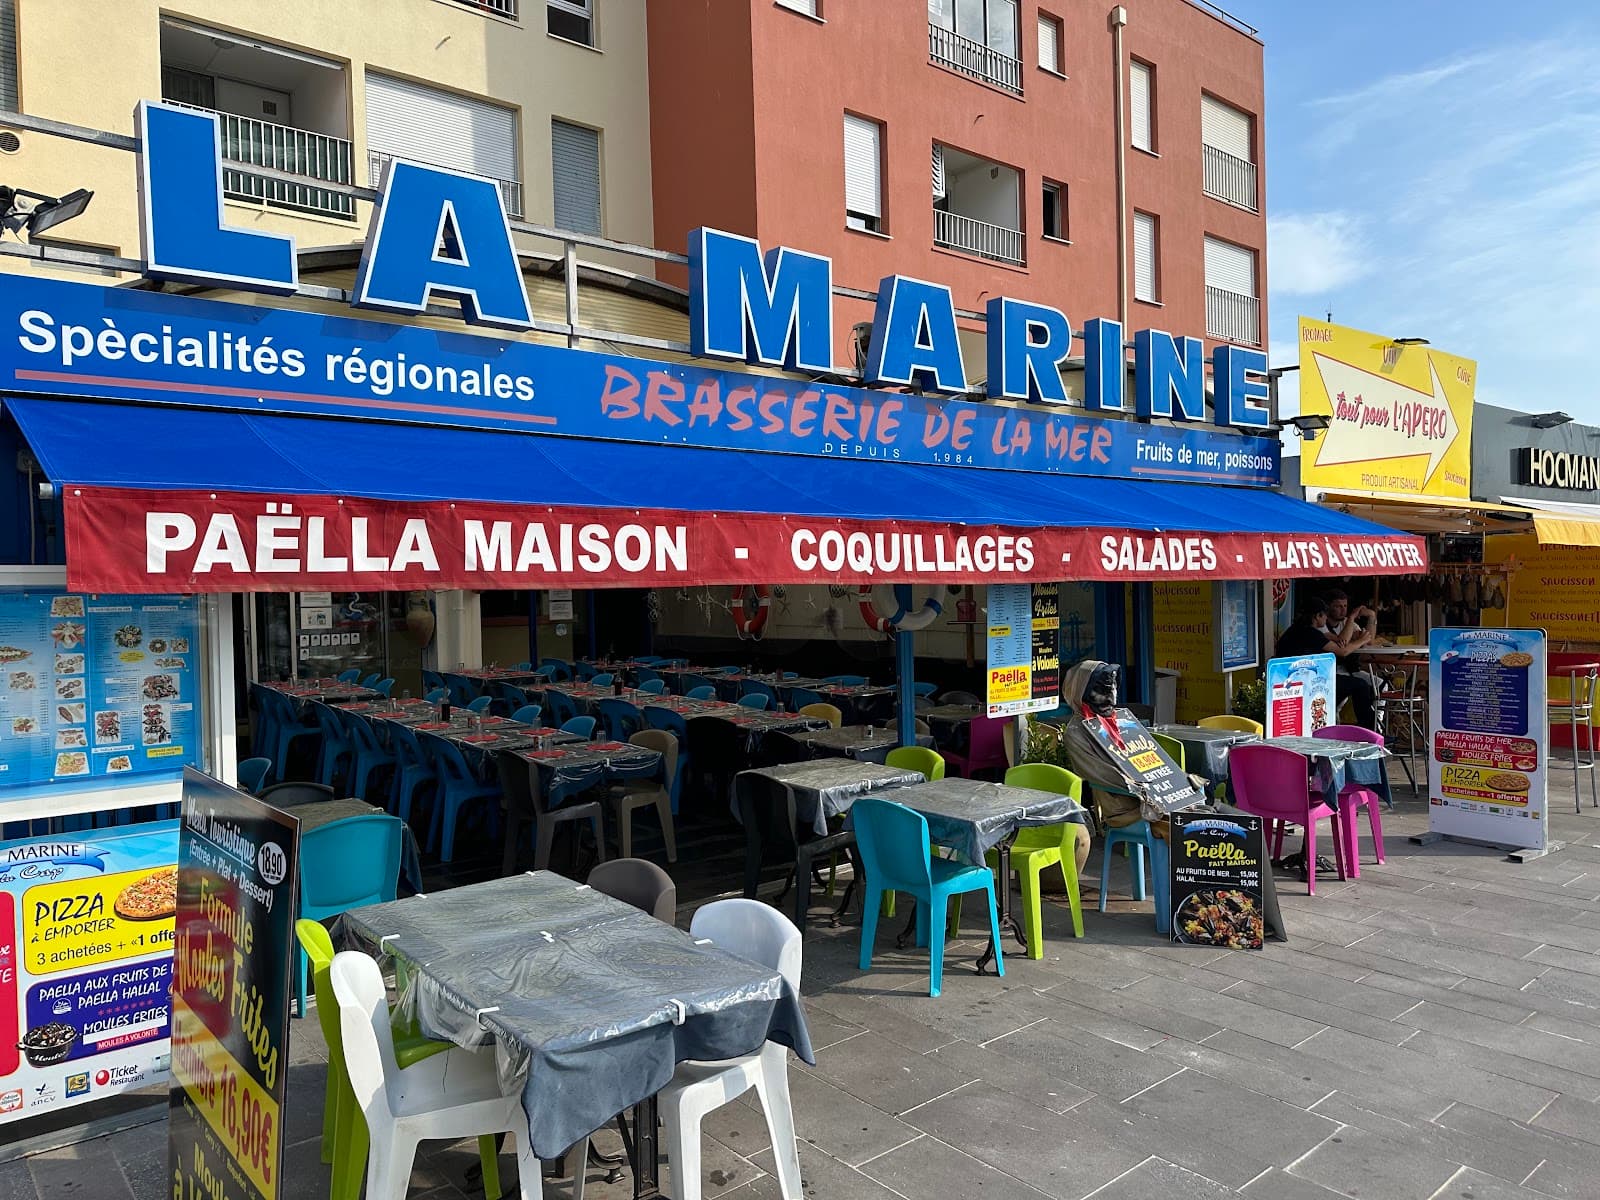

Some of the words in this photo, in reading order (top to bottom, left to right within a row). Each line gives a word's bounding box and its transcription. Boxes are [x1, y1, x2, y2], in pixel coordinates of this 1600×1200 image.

[134, 99, 535, 330] LA
[688, 226, 1269, 430] MARINE
[18, 309, 306, 377] Spècialités
[325, 350, 536, 401] régionales
[600, 364, 903, 444] BRASSERIE
[921, 403, 976, 450] DE
[991, 416, 1032, 458] LA
[1045, 421, 1112, 465] MER
[1336, 391, 1363, 423] tout
[1360, 404, 1390, 430] pour
[825, 442, 900, 459] DEPUIS
[1137, 439, 1174, 462] Fruits
[1178, 443, 1193, 465] de
[1196, 450, 1221, 470] mer,
[1225, 449, 1273, 471] poissons
[1361, 473, 1388, 488] PRODUIT
[145, 502, 441, 575] PAËLLA
[463, 519, 689, 573] MAISON
[791, 528, 1035, 575] COQUILLAGES
[1262, 541, 1325, 569] PLATS
[1325, 536, 1340, 568] À
[1341, 542, 1424, 568] EMPORTER
[1471, 650, 1497, 663] PIZZAS
[992, 669, 1026, 684] Paëlla
[1437, 732, 1460, 740] PAELLA
[1485, 735, 1495, 744] DE
[1443, 740, 1467, 748] PAELLA
[1461, 751, 1489, 760] MOULES
[1446, 767, 1480, 781] PIZZA
[1152, 780, 1173, 793] PLAT
[1163, 786, 1196, 804] DESSERT
[209, 807, 256, 866] Touristique
[8, 844, 81, 863] MARINE
[1183, 839, 1247, 860] Paëlla
[1176, 867, 1185, 875] AU
[1186, 867, 1207, 876] FRUITS
[1207, 869, 1216, 877] DE
[1216, 870, 1230, 878] MER
[1226, 859, 1257, 867] MAISON
[217, 856, 232, 881] Plat
[239, 871, 274, 914] Dessert)
[35, 892, 104, 927] PIZZA
[200, 876, 254, 955] Formule
[44, 917, 116, 941] EMPORTER
[36, 952, 46, 966] 3
[50, 941, 113, 963] achetées
[39, 981, 81, 1002] PAELLA
[83, 975, 109, 993] AUX
[112, 965, 149, 988] FRUITS
[152, 963, 168, 978] DE
[78, 991, 118, 1010] PAELLA
[122, 980, 161, 999] HALLAL
[83, 1018, 129, 1035] MOULES
[132, 1005, 168, 1024] FRITES
[178, 927, 225, 1003] Moules
[231, 946, 278, 1091] Frites
[97, 1036, 125, 1050] MOULES
[110, 1064, 139, 1079] Ticket
[110, 1072, 145, 1087] Restaurant
[219, 1064, 273, 1185] 16,90€
